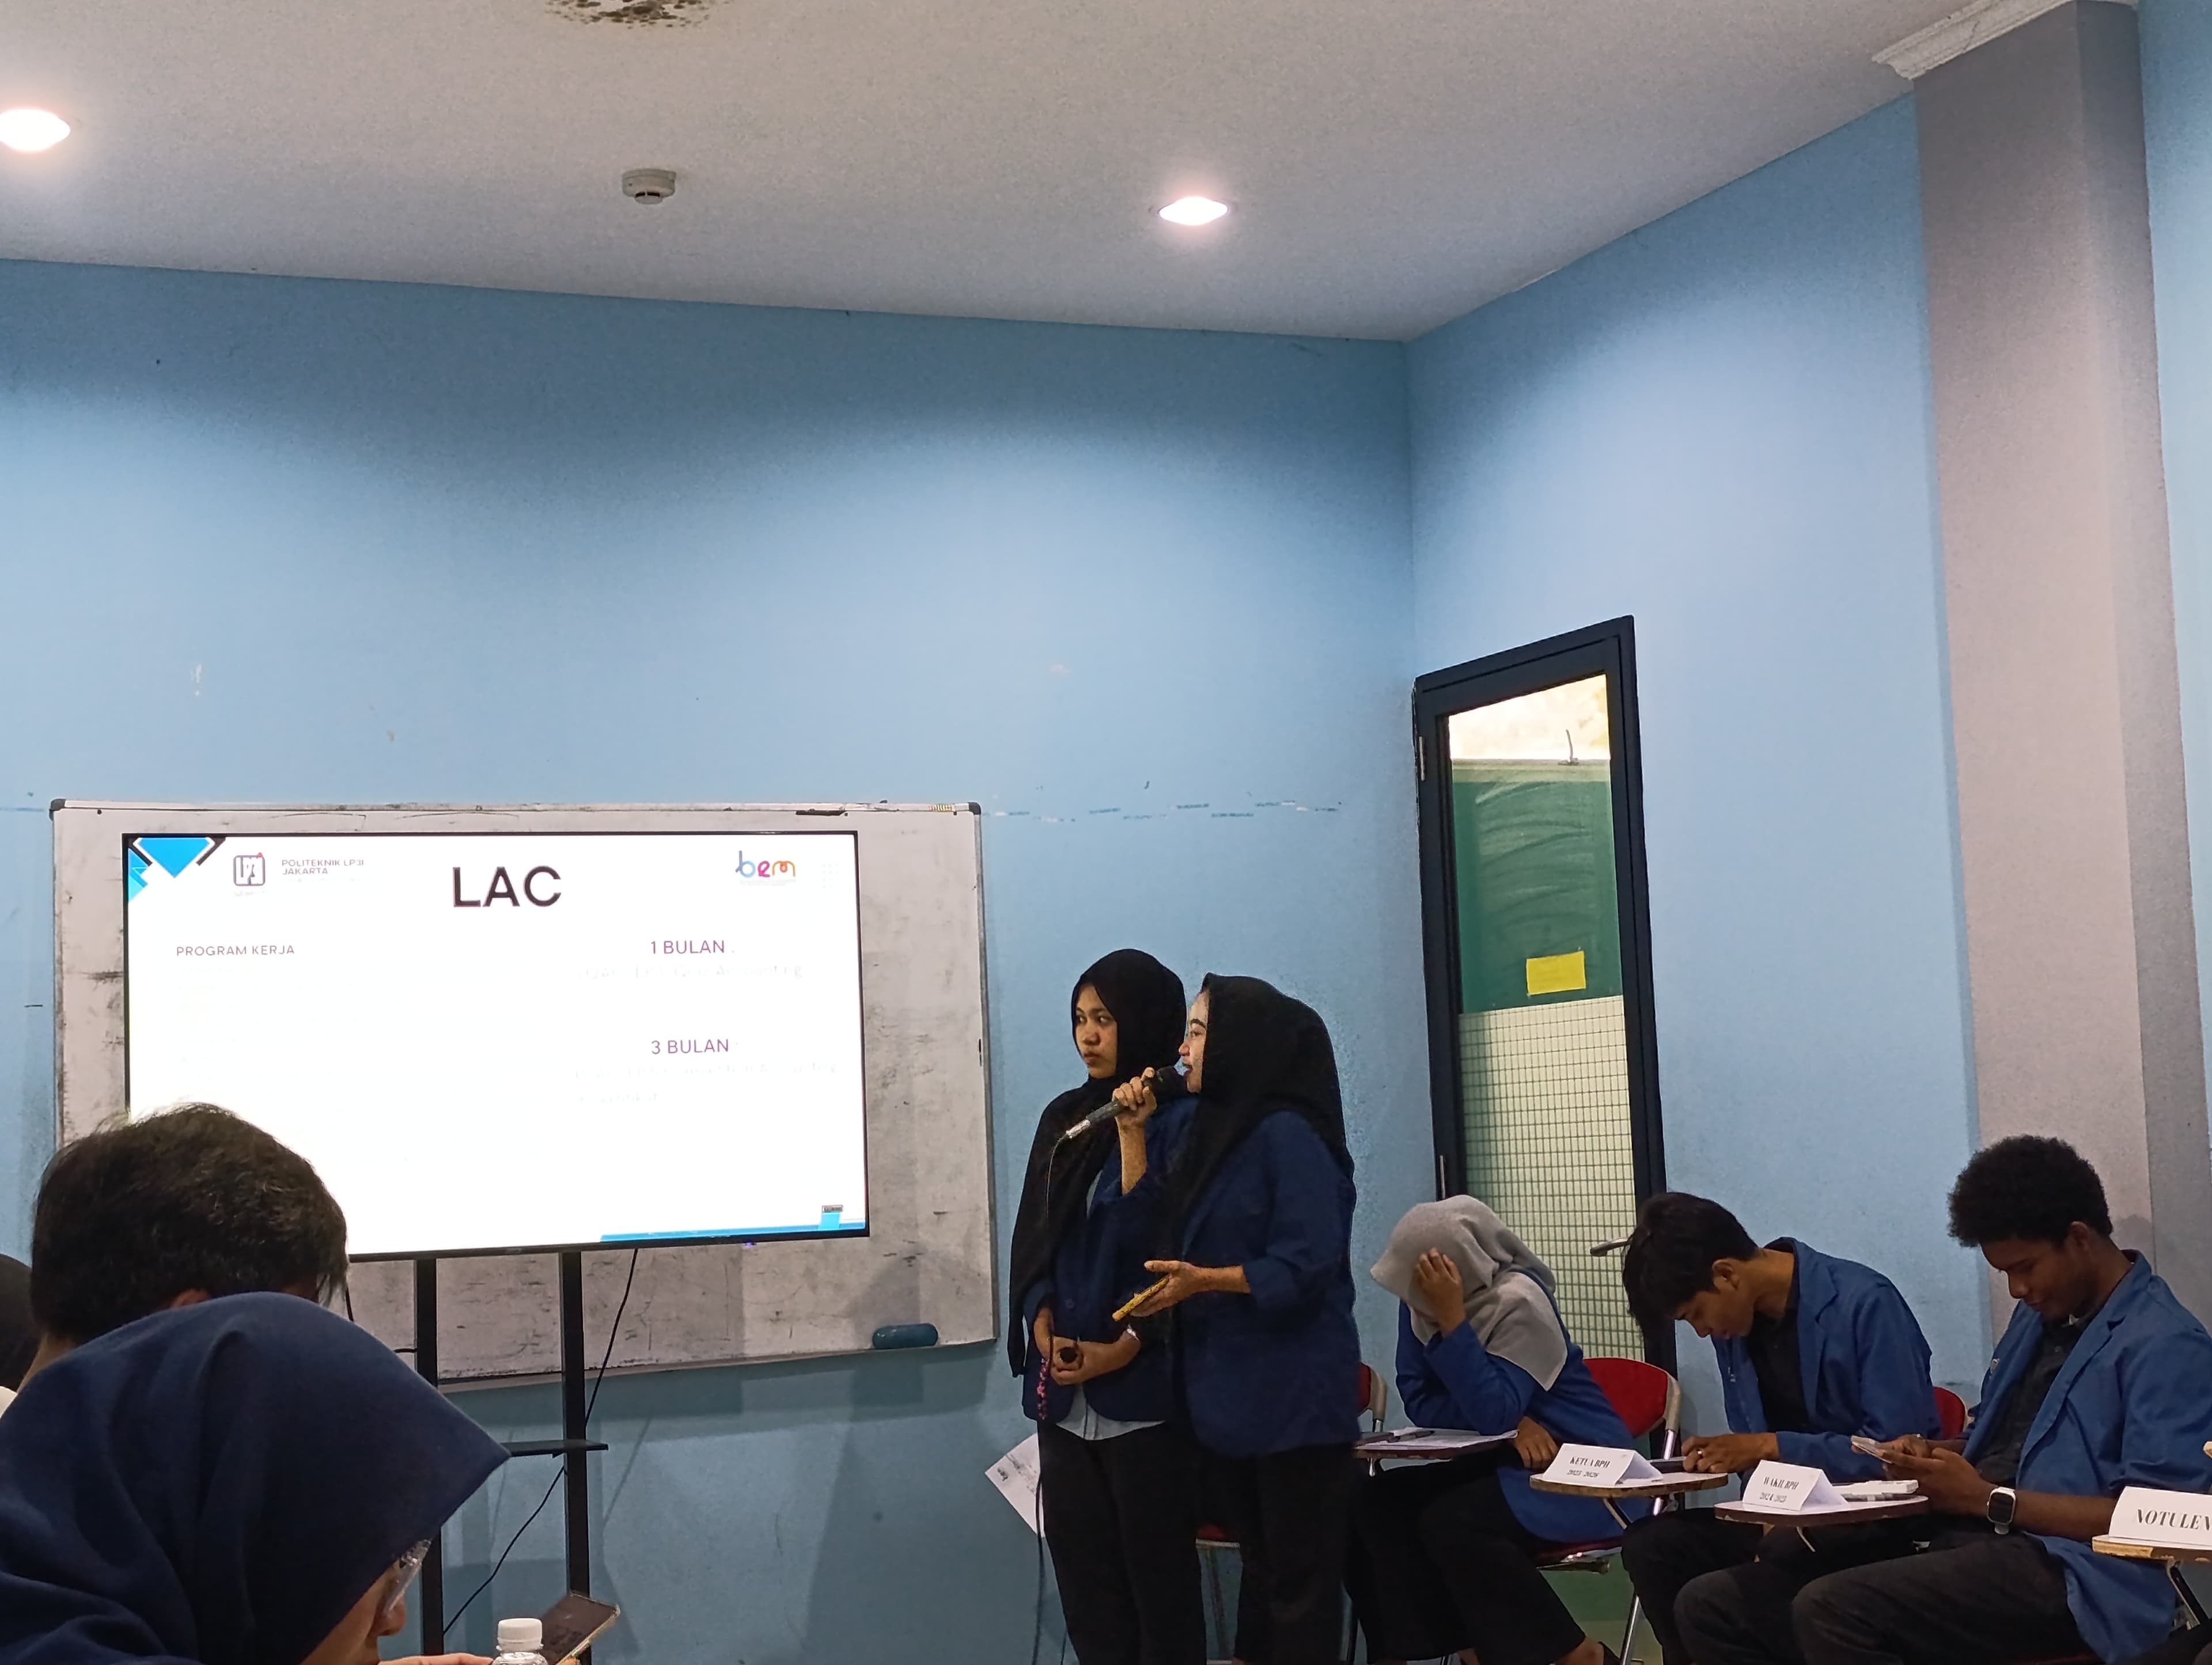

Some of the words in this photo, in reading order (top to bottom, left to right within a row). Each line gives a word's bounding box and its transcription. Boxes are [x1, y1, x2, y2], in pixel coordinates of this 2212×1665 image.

[281, 859, 341, 867] POLITEKNIK
[736, 850, 796, 878] bem
[282, 867, 328, 875] JAKARTA
[452, 865, 562, 908] LAC
[176, 946, 247, 957] PROGRAM
[252, 945, 295, 955] KERJA
[650, 940, 657, 954] 1
[663, 939, 725, 954] BULAN
[651, 1040, 661, 1055] 3
[667, 1038, 729, 1054] BULAN
